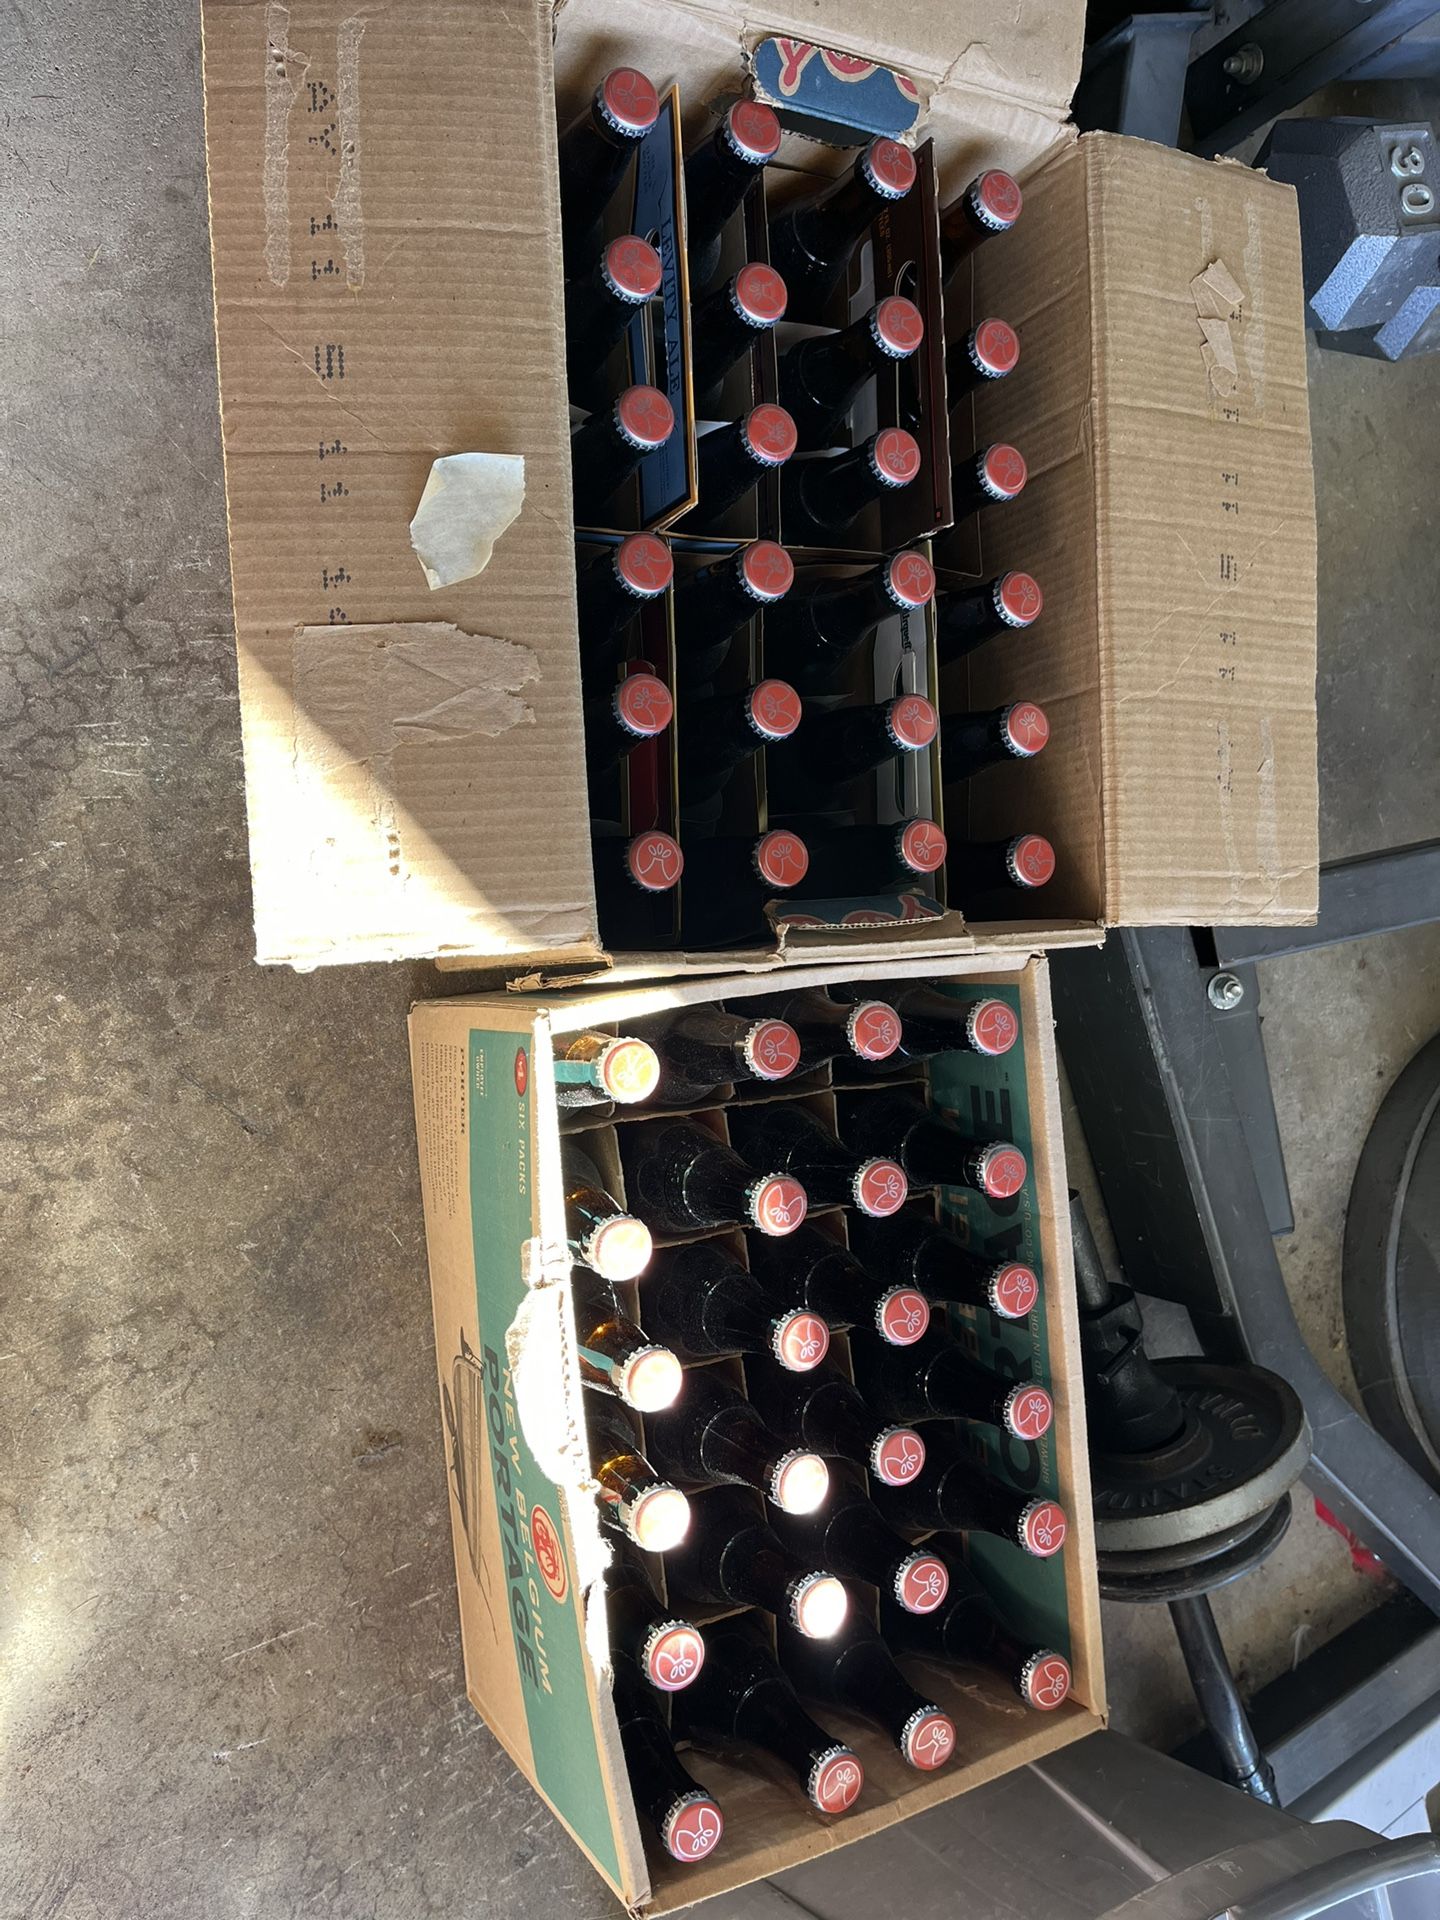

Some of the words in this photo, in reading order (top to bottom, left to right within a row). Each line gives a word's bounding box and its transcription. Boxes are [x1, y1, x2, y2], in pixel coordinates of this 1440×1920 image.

[1390, 145, 1435, 214] 30
[661, 216, 678, 322] LEVITY
[667, 339, 680, 396] ALE
[517, 1102, 527, 1129] SIX
[517, 1139, 527, 1195] PACKS
[484, 1344, 539, 1689] PORTAGE
[503, 1368, 523, 1475] NEW
[514, 1488, 552, 1694] BELGIUM
